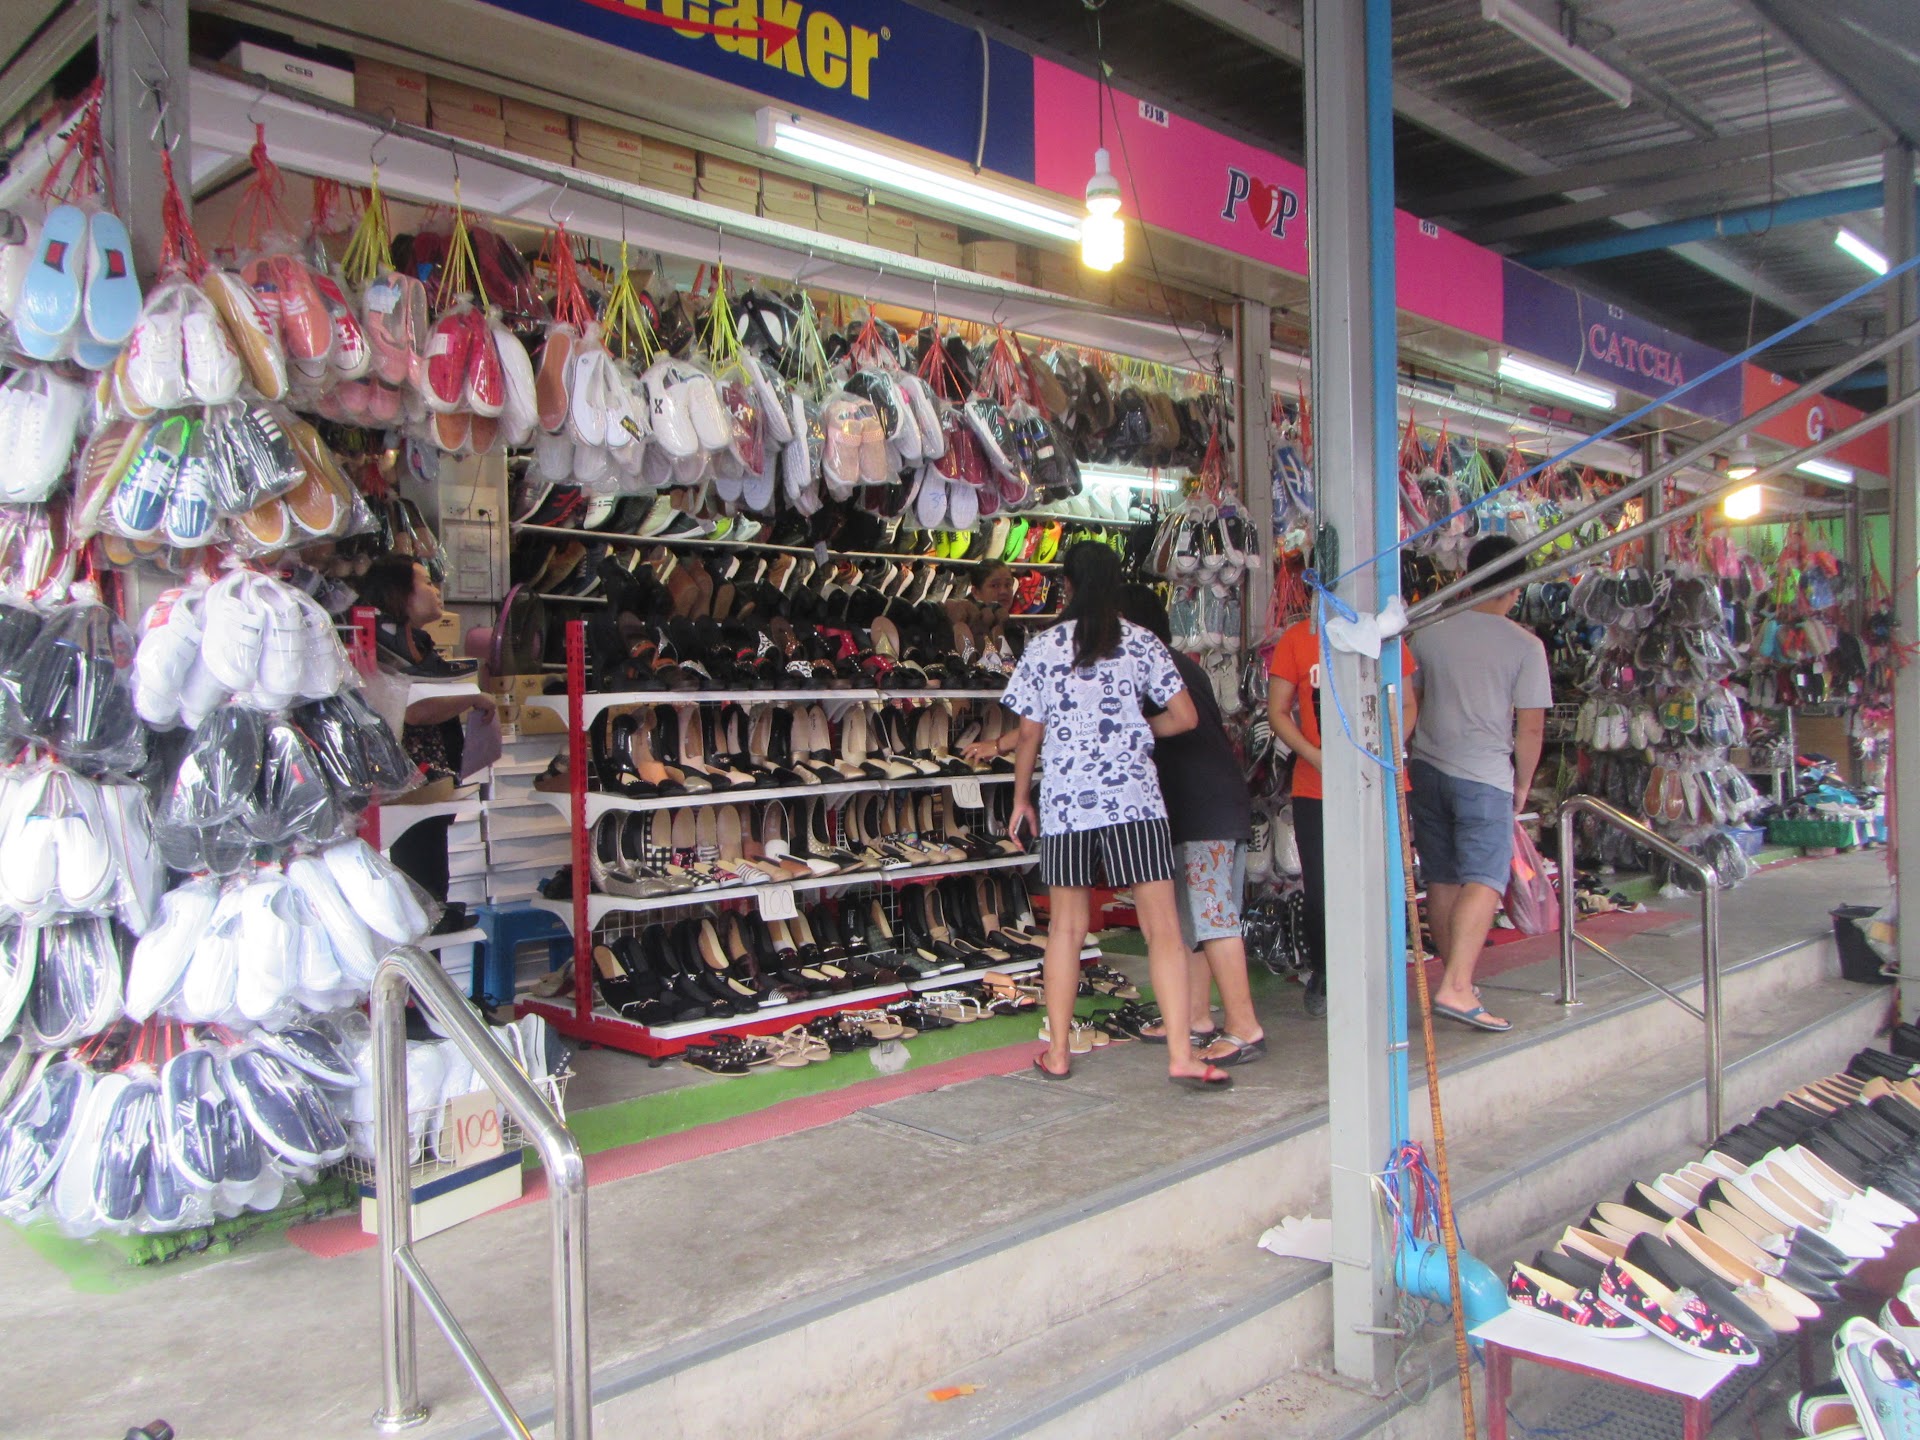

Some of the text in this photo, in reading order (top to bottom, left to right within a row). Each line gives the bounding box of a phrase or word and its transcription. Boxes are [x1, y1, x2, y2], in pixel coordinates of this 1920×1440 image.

[1589, 324, 1684, 386] CATCHA
[763, 889, 793, 916] 100
[457, 1109, 501, 1155] 109
